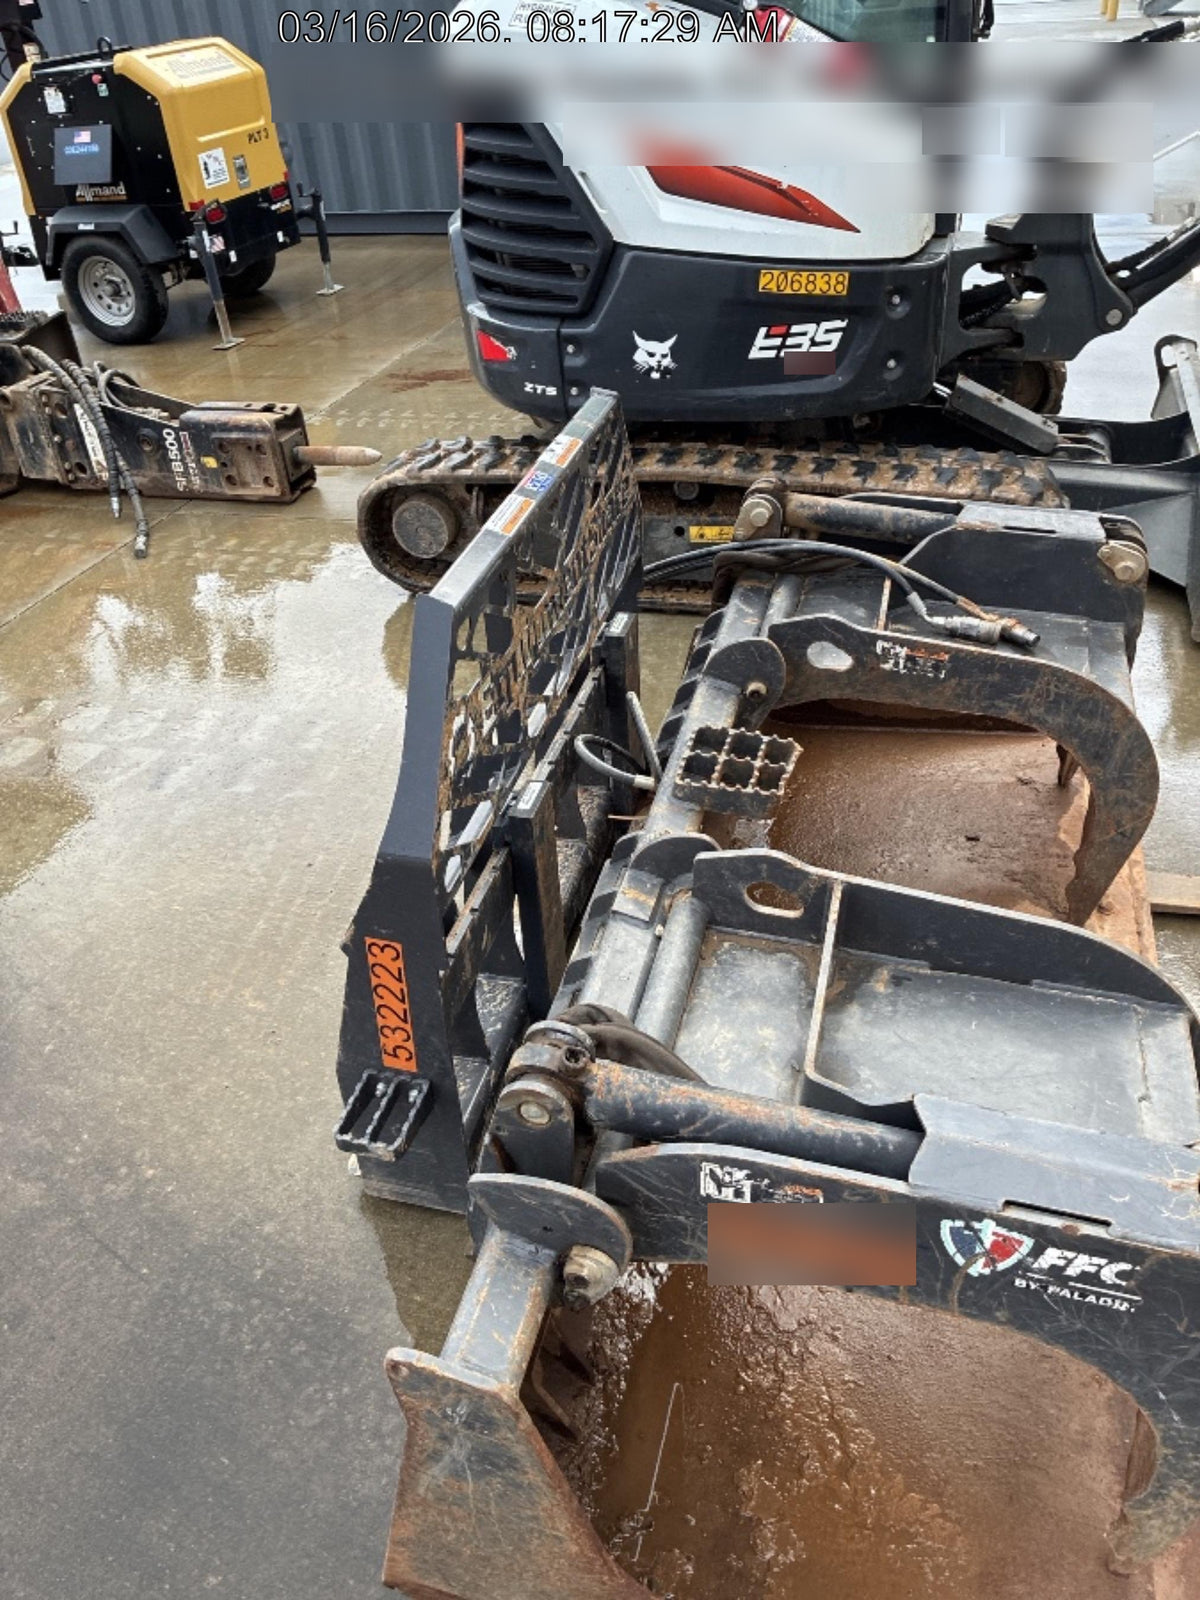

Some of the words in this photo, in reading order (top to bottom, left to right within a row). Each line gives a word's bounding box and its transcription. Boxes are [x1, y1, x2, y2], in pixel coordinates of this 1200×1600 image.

[75, 181, 127, 202] Allmand
[761, 271, 847, 296] 206838
[748, 318, 849, 359] E35
[523, 381, 558, 396] ZTS
[367, 941, 414, 1062] 532223
[1031, 1246, 1136, 1286] FFC
[1013, 1277, 1042, 1292] BY
